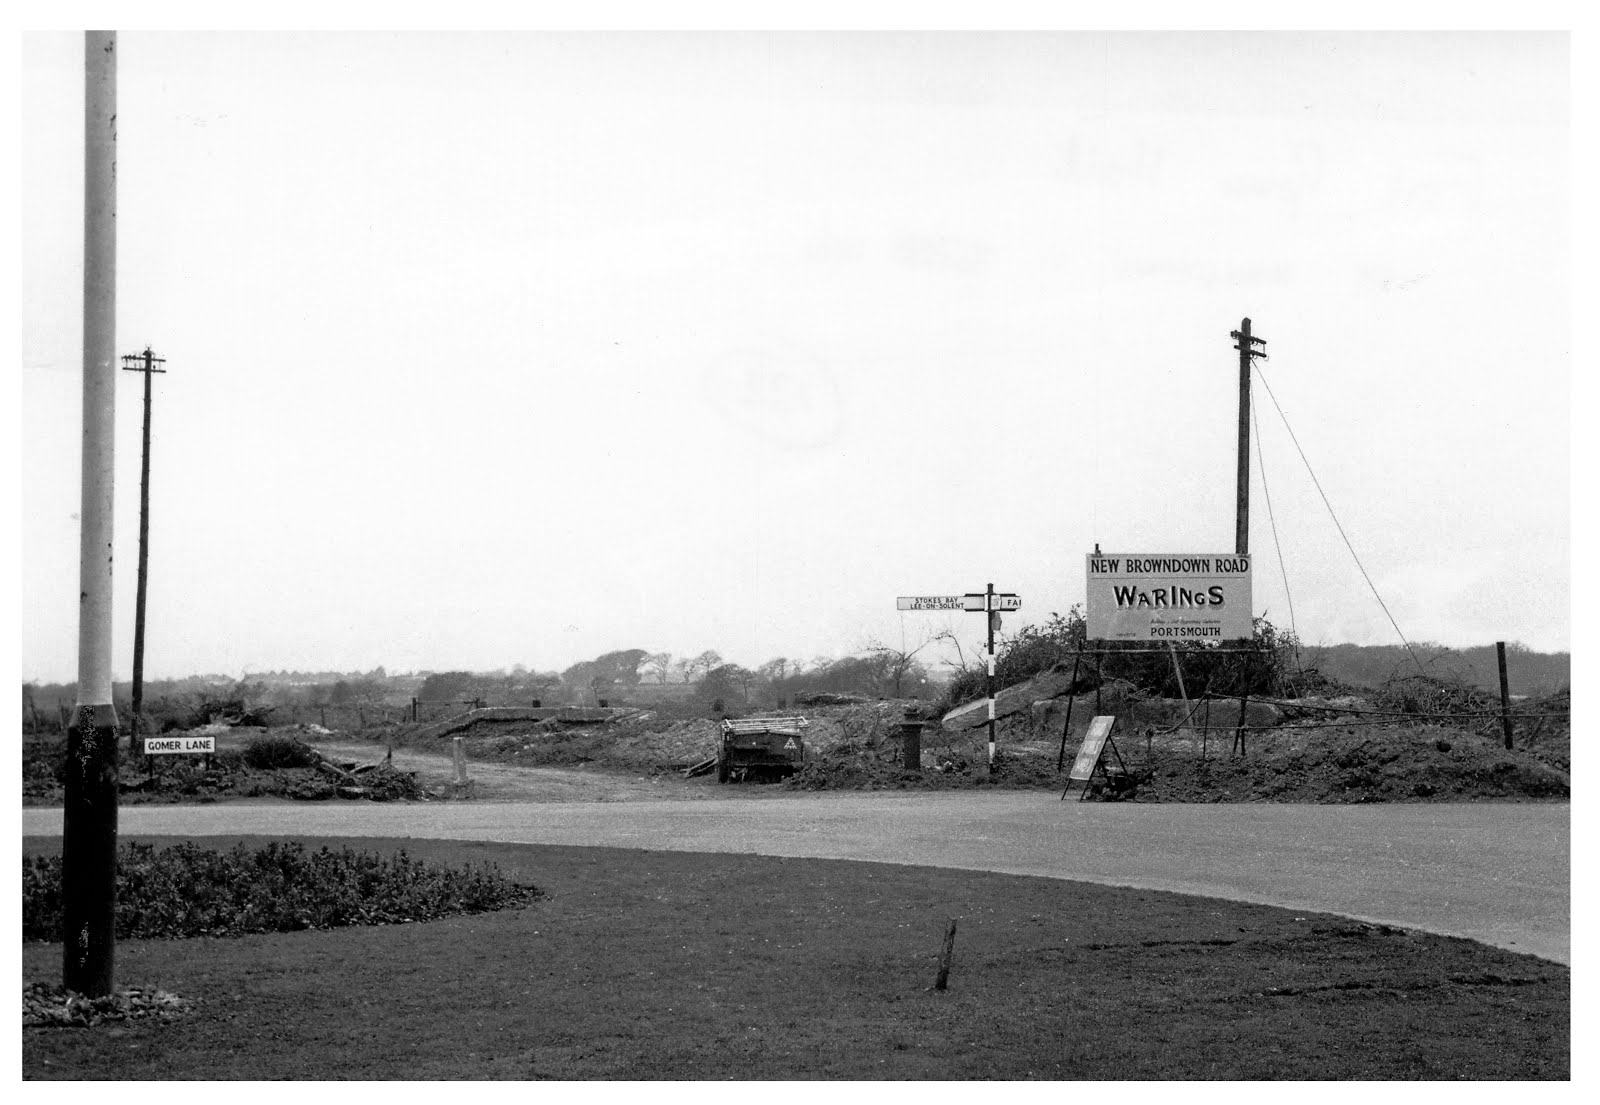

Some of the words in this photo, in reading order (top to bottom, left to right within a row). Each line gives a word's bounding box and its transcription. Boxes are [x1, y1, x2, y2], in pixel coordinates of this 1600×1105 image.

[1091, 559, 1119, 573] NEW
[1126, 559, 1210, 573] BROWNDOWN
[1215, 558, 1249, 573] ROAD
[1150, 627, 1221, 637] PORTSMOUTH
[148, 740, 181, 751] GOMER
[186, 740, 212, 750] LANE
